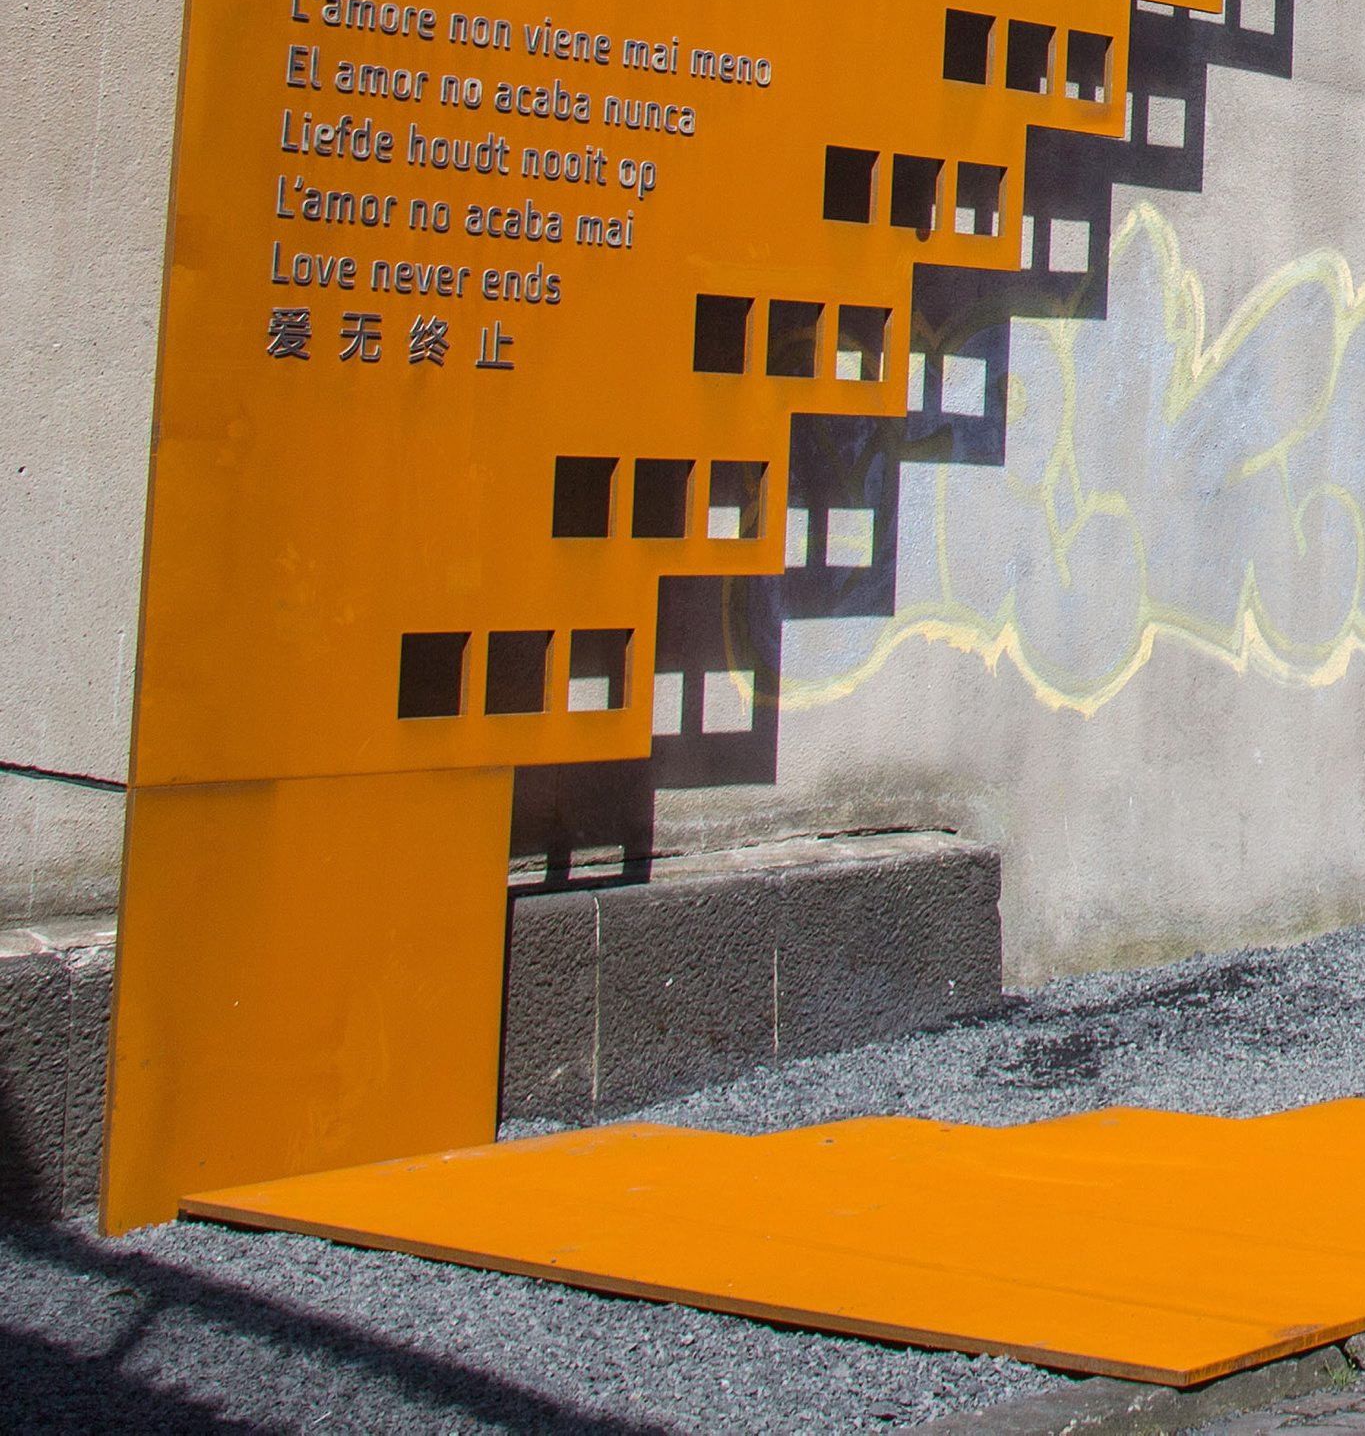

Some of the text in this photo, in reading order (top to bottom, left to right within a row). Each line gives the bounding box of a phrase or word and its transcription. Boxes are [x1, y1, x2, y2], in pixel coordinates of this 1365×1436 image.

[449, 11, 512, 51] non
[524, 17, 612, 64] viene
[623, 36, 679, 75] mai
[690, 49, 773, 87] meno
[287, 45, 697, 135] El amor no acaba nunca
[281, 108, 657, 199] Liefde houdt nooit op
[276, 175, 635, 248] L'amor no acaba mai
[271, 241, 563, 305] Love never ends
